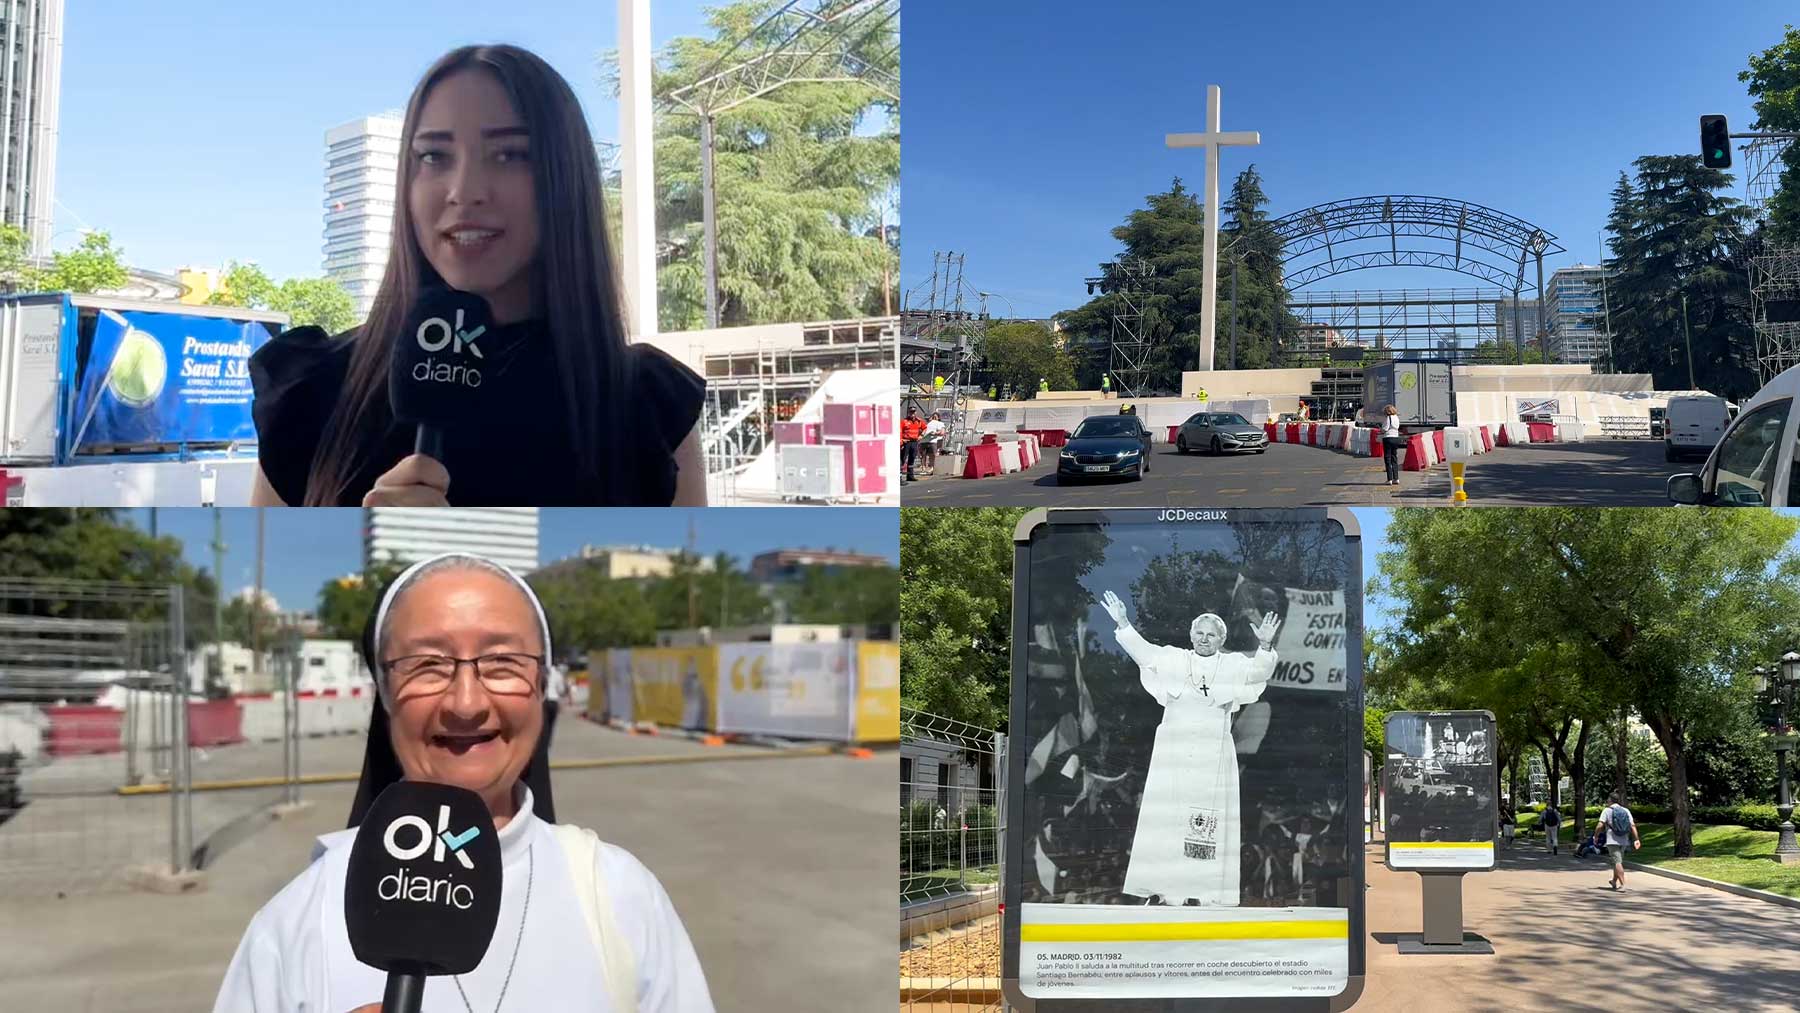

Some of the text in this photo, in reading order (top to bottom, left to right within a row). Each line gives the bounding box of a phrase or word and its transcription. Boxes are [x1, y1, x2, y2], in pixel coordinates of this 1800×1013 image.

[180, 357, 221, 377] Sarai
[412, 356, 482, 388] diario
[1157, 509, 1228, 521] JCDecaux
[1299, 591, 1334, 607] JUAN
[378, 867, 474, 910] diario
[1036, 952, 1123, 961] 05. MADRID. 03/11/1982
[1036, 962, 1054, 970] Juan
[1055, 962, 1074, 970] Pablo
[1081, 962, 1104, 970] saluda
[1111, 962, 1118, 970] la
[1274, 960, 1281, 968] el
[1282, 960, 1309, 968] estadio
[1036, 971, 1067, 980] Santiago
[1124, 971, 1156, 980] aplausos
[1211, 969, 1223, 977] del
